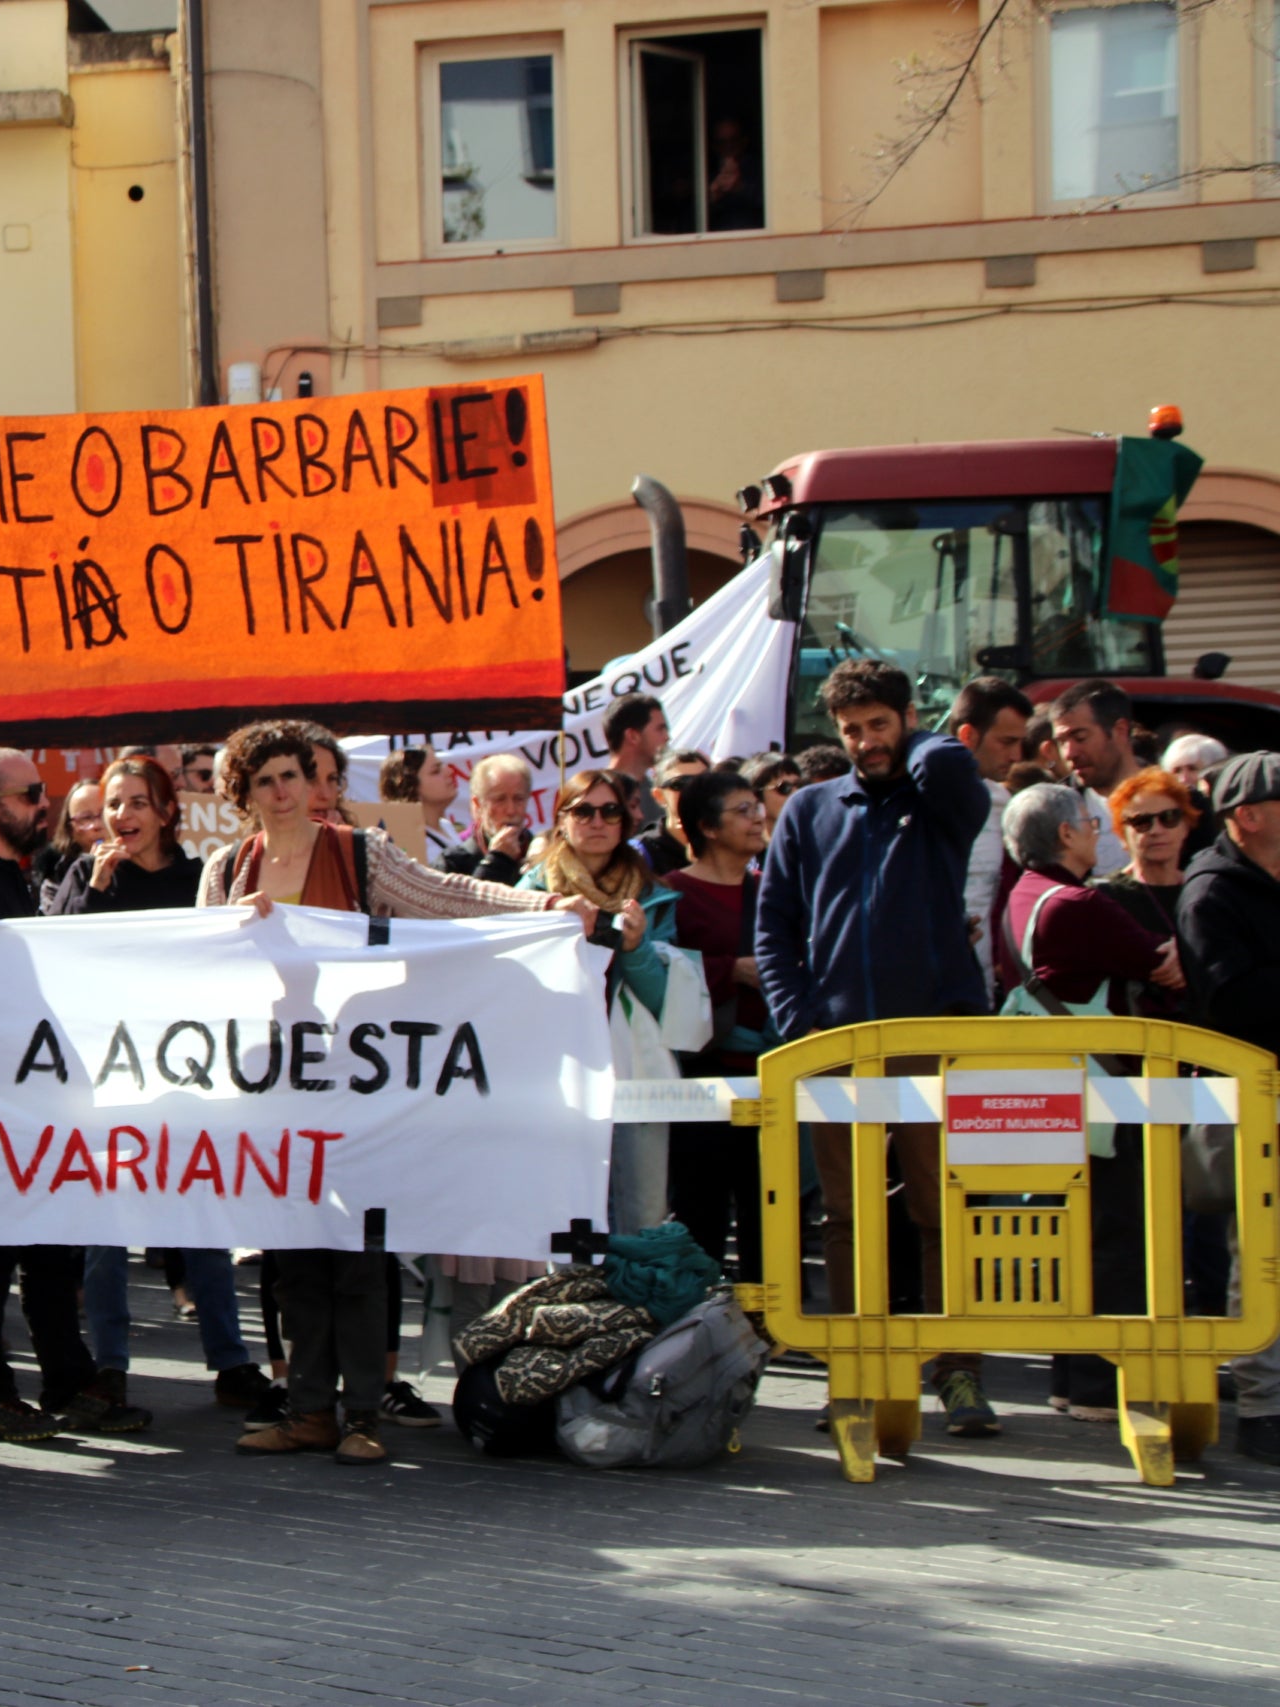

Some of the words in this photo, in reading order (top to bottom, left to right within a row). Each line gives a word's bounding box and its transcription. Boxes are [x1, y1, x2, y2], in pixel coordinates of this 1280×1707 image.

[71, 425, 121, 518] O
[145, 542, 195, 636] O
[215, 508, 547, 636] TIRANIA!
[13, 1018, 69, 1086] A
[93, 1017, 492, 1098] AQUESTA
[952, 1116, 1003, 1130] DIPÒSIT
[1006, 1117, 1079, 1130] MUNICIPAL
[982, 1098, 1048, 1109] RESERVAT
